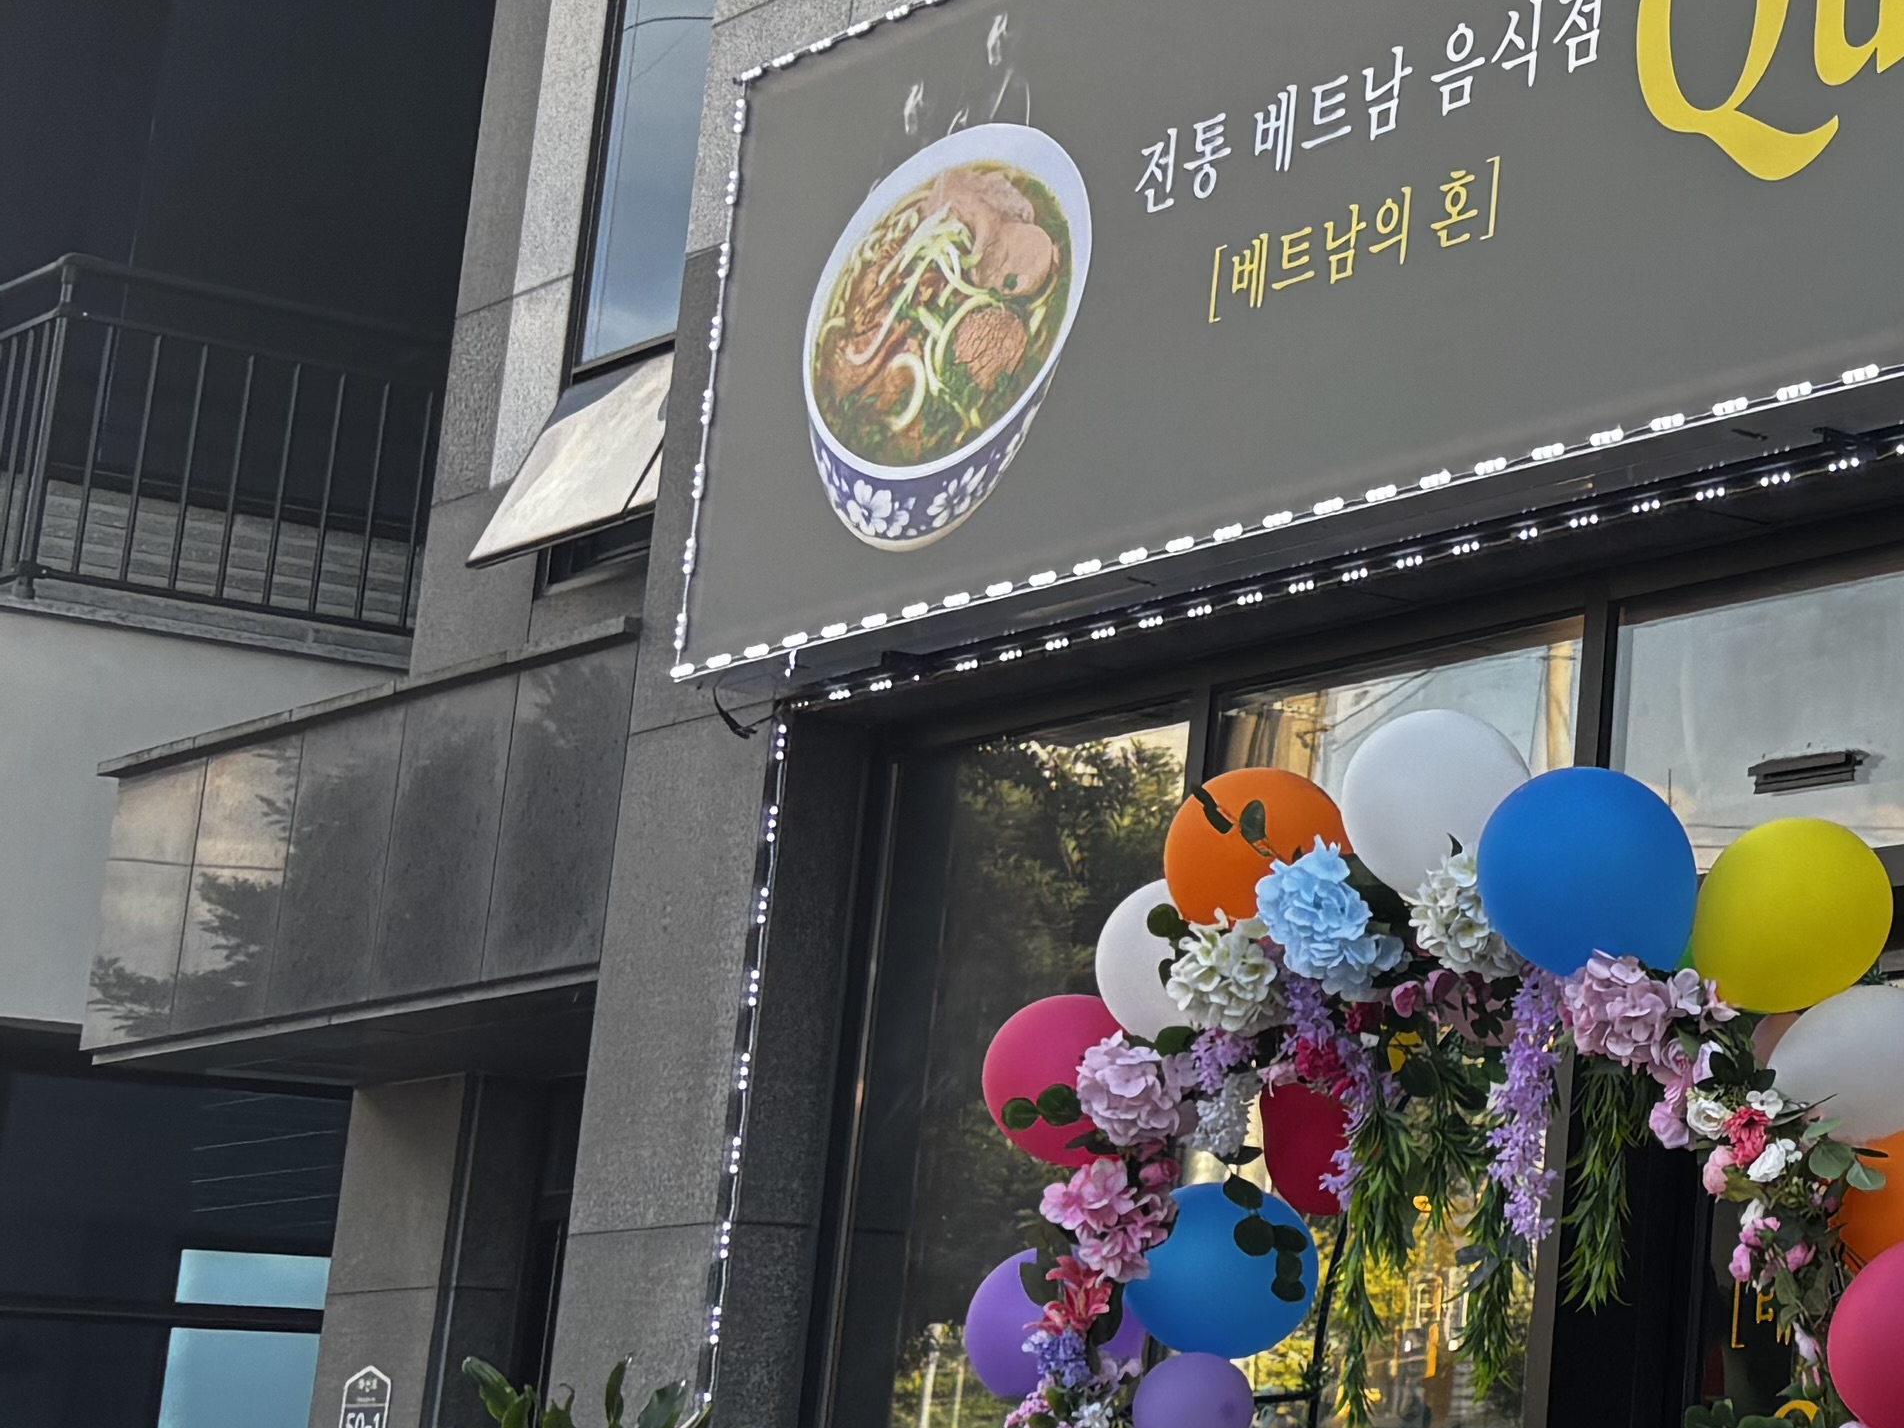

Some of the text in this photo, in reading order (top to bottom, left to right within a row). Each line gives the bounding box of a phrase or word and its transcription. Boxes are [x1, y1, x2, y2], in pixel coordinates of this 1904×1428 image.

[1134, 112, 1226, 212] 전통
[1253, 45, 1413, 172] 베트남
[1208, 156, 1501, 321] [베트남의 혼]
